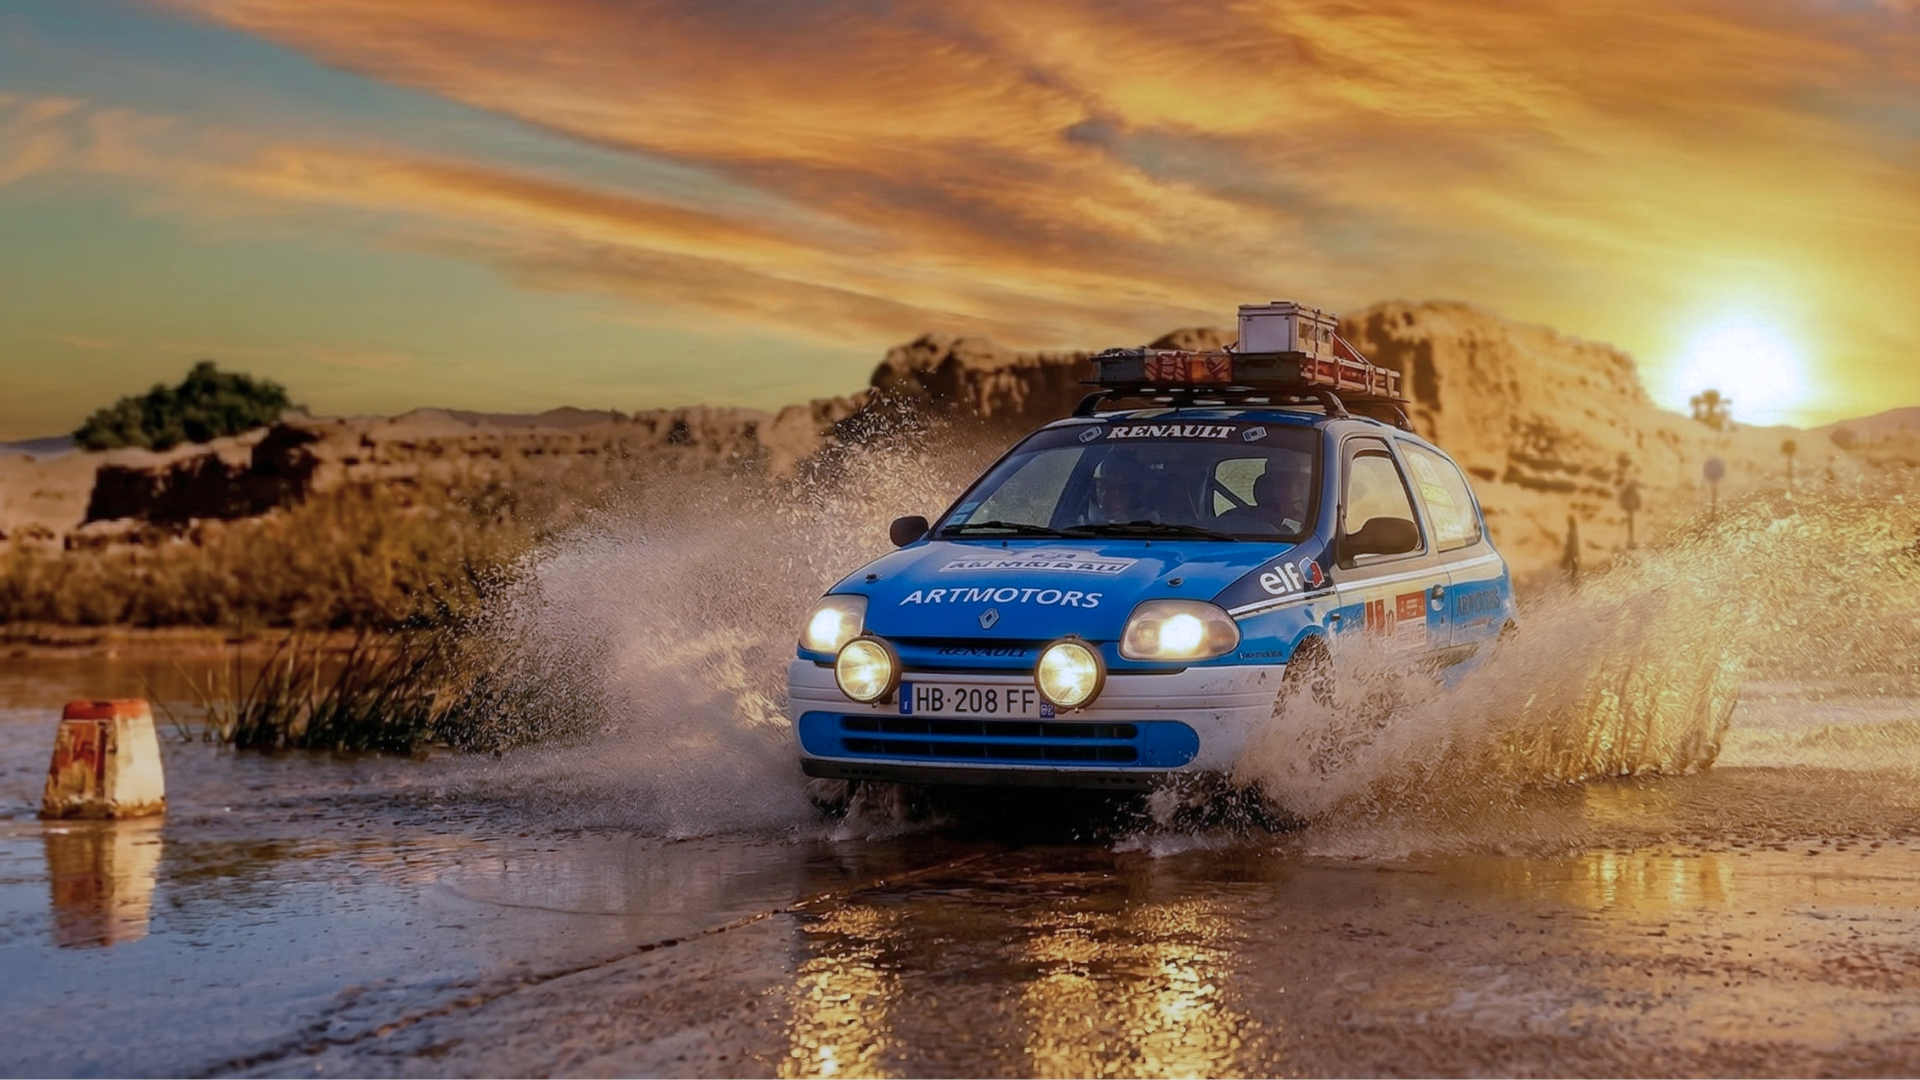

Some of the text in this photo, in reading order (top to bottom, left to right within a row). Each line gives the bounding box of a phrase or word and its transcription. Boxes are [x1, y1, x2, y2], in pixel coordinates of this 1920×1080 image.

[1106, 425, 1237, 439] RENAULT
[1259, 562, 1302, 595] elf
[899, 587, 1104, 609] ARTMOTORS
[1005, 689, 1036, 714] FF
